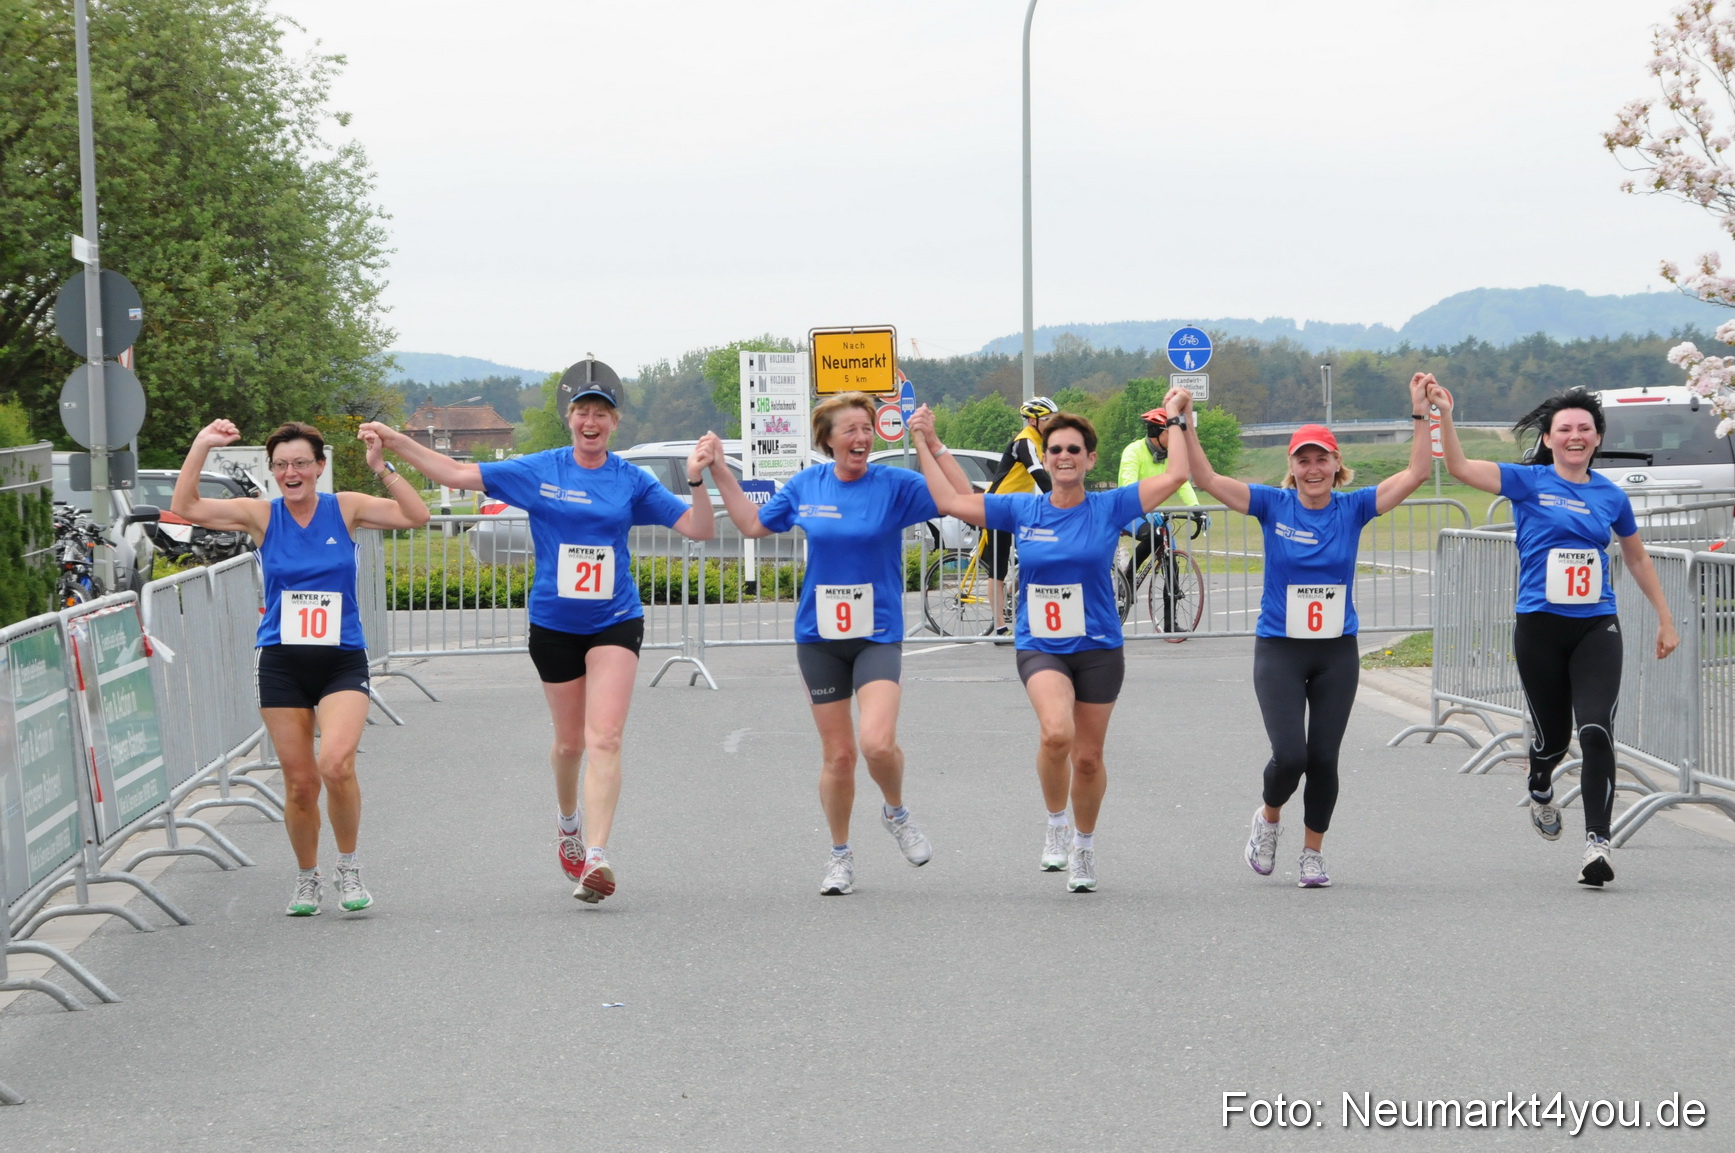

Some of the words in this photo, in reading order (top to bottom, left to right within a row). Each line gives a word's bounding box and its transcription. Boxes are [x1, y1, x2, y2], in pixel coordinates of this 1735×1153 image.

[822, 353, 886, 369] Neumarkt
[844, 375, 850, 383] 5
[856, 375, 867, 383] km
[757, 397, 770, 413] SHB
[757, 439, 779, 455] THULE
[568, 547, 595, 555] MEYER
[1558, 552, 1586, 560] MEYER
[574, 561, 602, 592] 21
[1565, 566, 1591, 597] 13
[298, 607, 327, 638] 10
[836, 602, 851, 633] 9
[1045, 601, 1062, 631] 8
[1308, 601, 1323, 632] 6
[811, 686, 836, 695] ODLO
